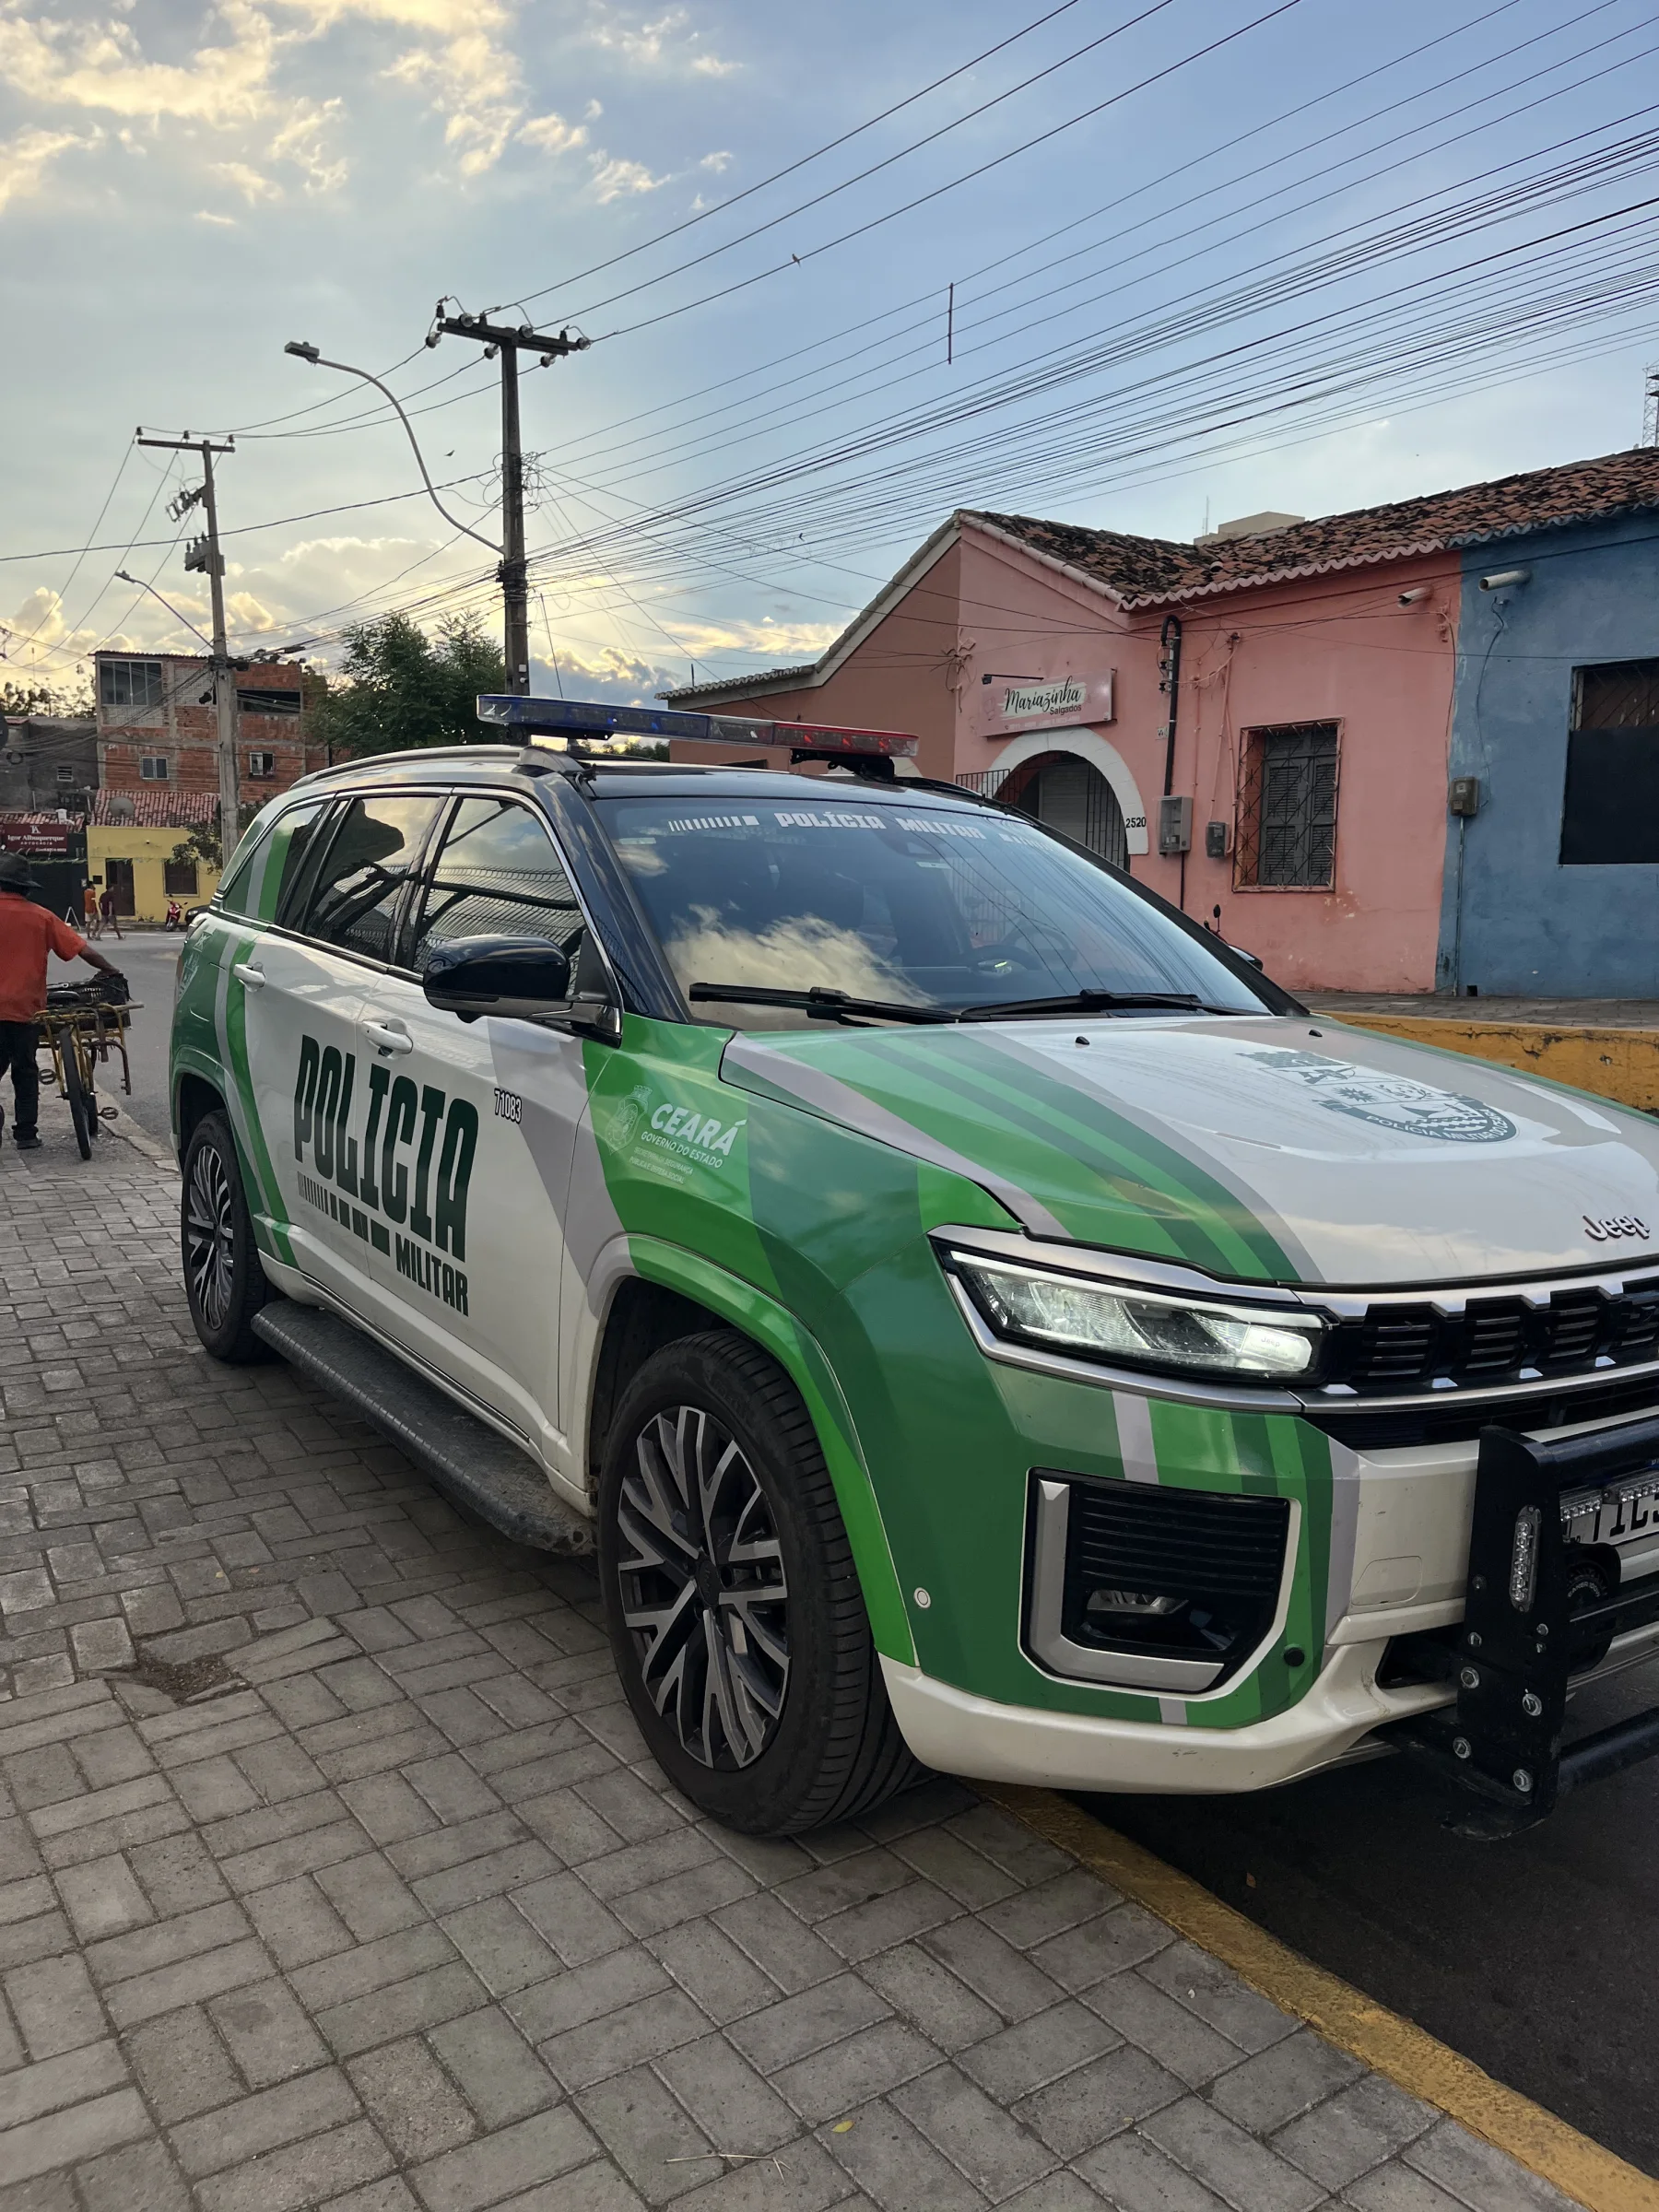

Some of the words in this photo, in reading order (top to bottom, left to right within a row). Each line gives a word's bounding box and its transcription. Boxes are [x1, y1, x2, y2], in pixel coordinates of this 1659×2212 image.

[1005, 676, 1082, 713] Mariazinha
[1050, 704, 1082, 716] Salgados
[774, 811, 887, 830] POLÍCIA
[895, 818, 986, 840] MILITAR
[1125, 817, 1147, 829] 2520
[22, 834, 65, 842] Albuquerque
[494, 1088, 522, 1124] 71083
[651, 1103, 747, 1156] CEARÁ
[1366, 1115, 1442, 1137] POLÍCIA
[1442, 1132, 1498, 1140] MILITAR
[641, 1131, 677, 1151] GOVERNO
[677, 1145, 690, 1157] DO
[689, 1148, 724, 1169] ESTADO
[666, 1171, 686, 1184] SOCIAL
[1583, 1215, 1650, 1241] Jeep
[395, 1231, 469, 1317] MILITAR
